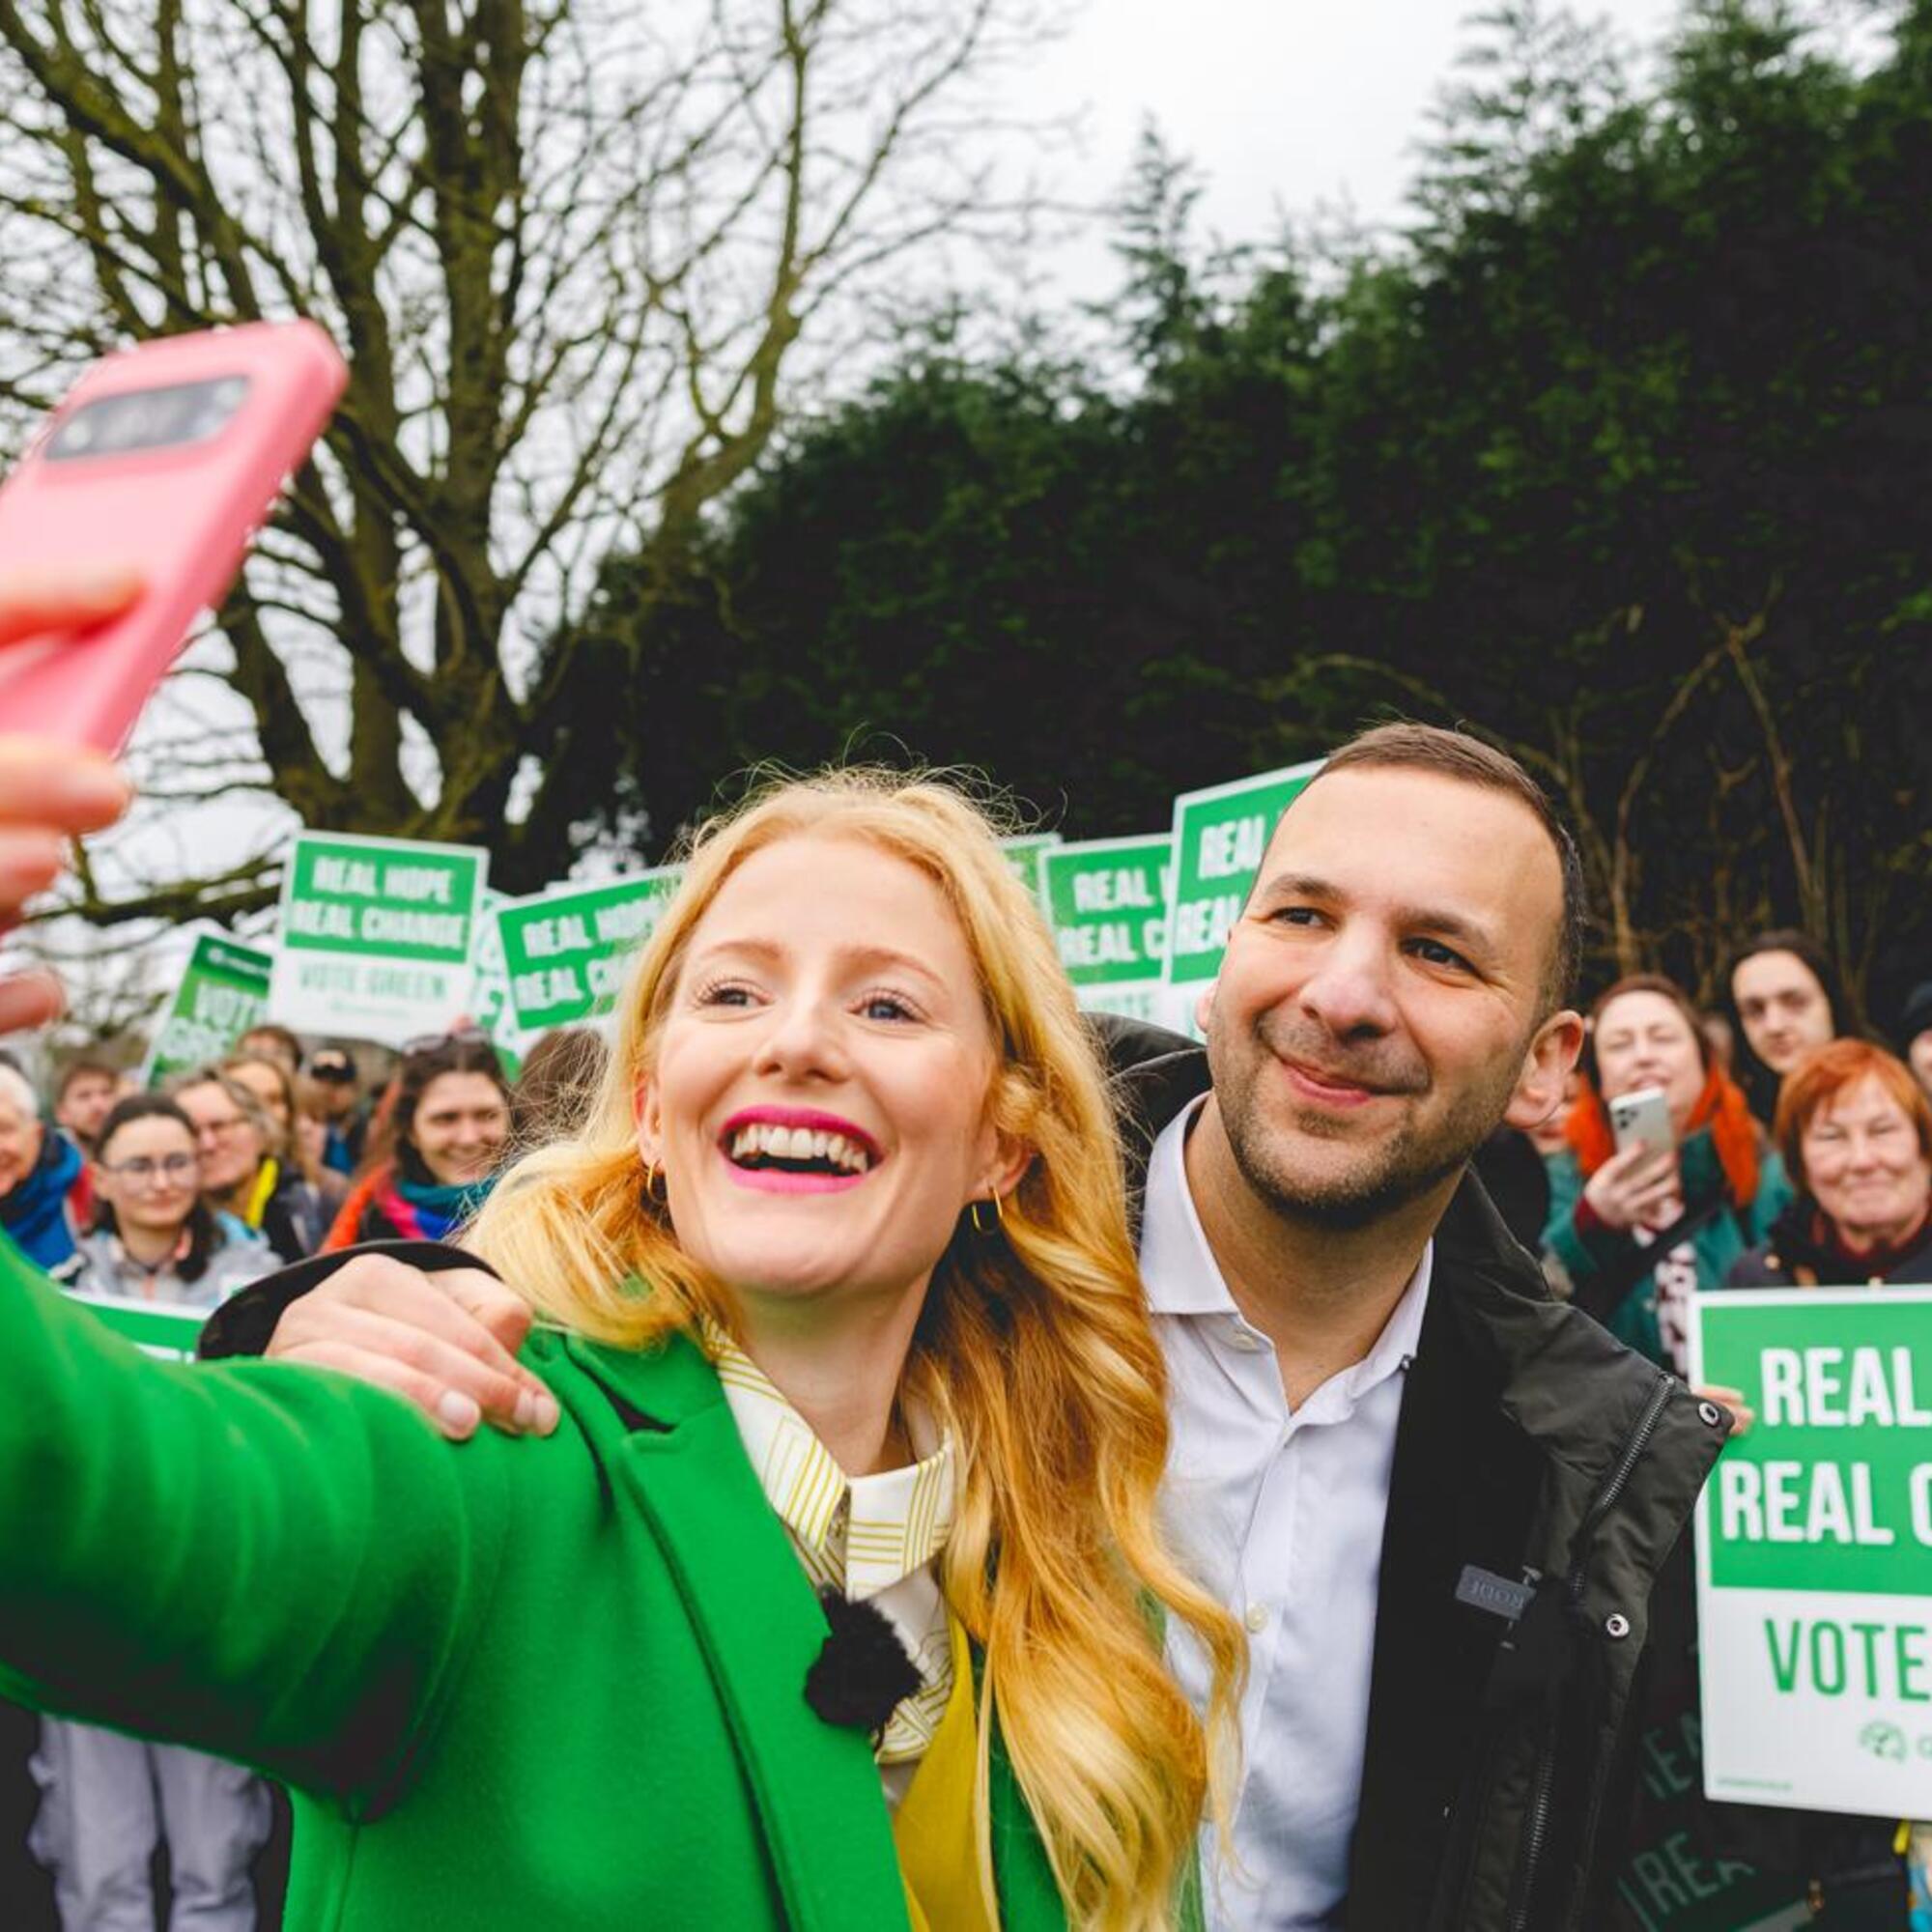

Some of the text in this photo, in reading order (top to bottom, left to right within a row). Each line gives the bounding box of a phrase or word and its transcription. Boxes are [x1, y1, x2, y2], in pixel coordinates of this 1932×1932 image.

[312, 855, 453, 904] REAL HOPE
[1072, 868, 1155, 914] REAL
[289, 899, 353, 940] REAL
[523, 913, 593, 959] REAL
[513, 967, 584, 1010] REAL
[1760, 1347, 1932, 1428] REAL
[1719, 1459, 1895, 1546] REAL
[1764, 1618, 1931, 1702] VOTE
